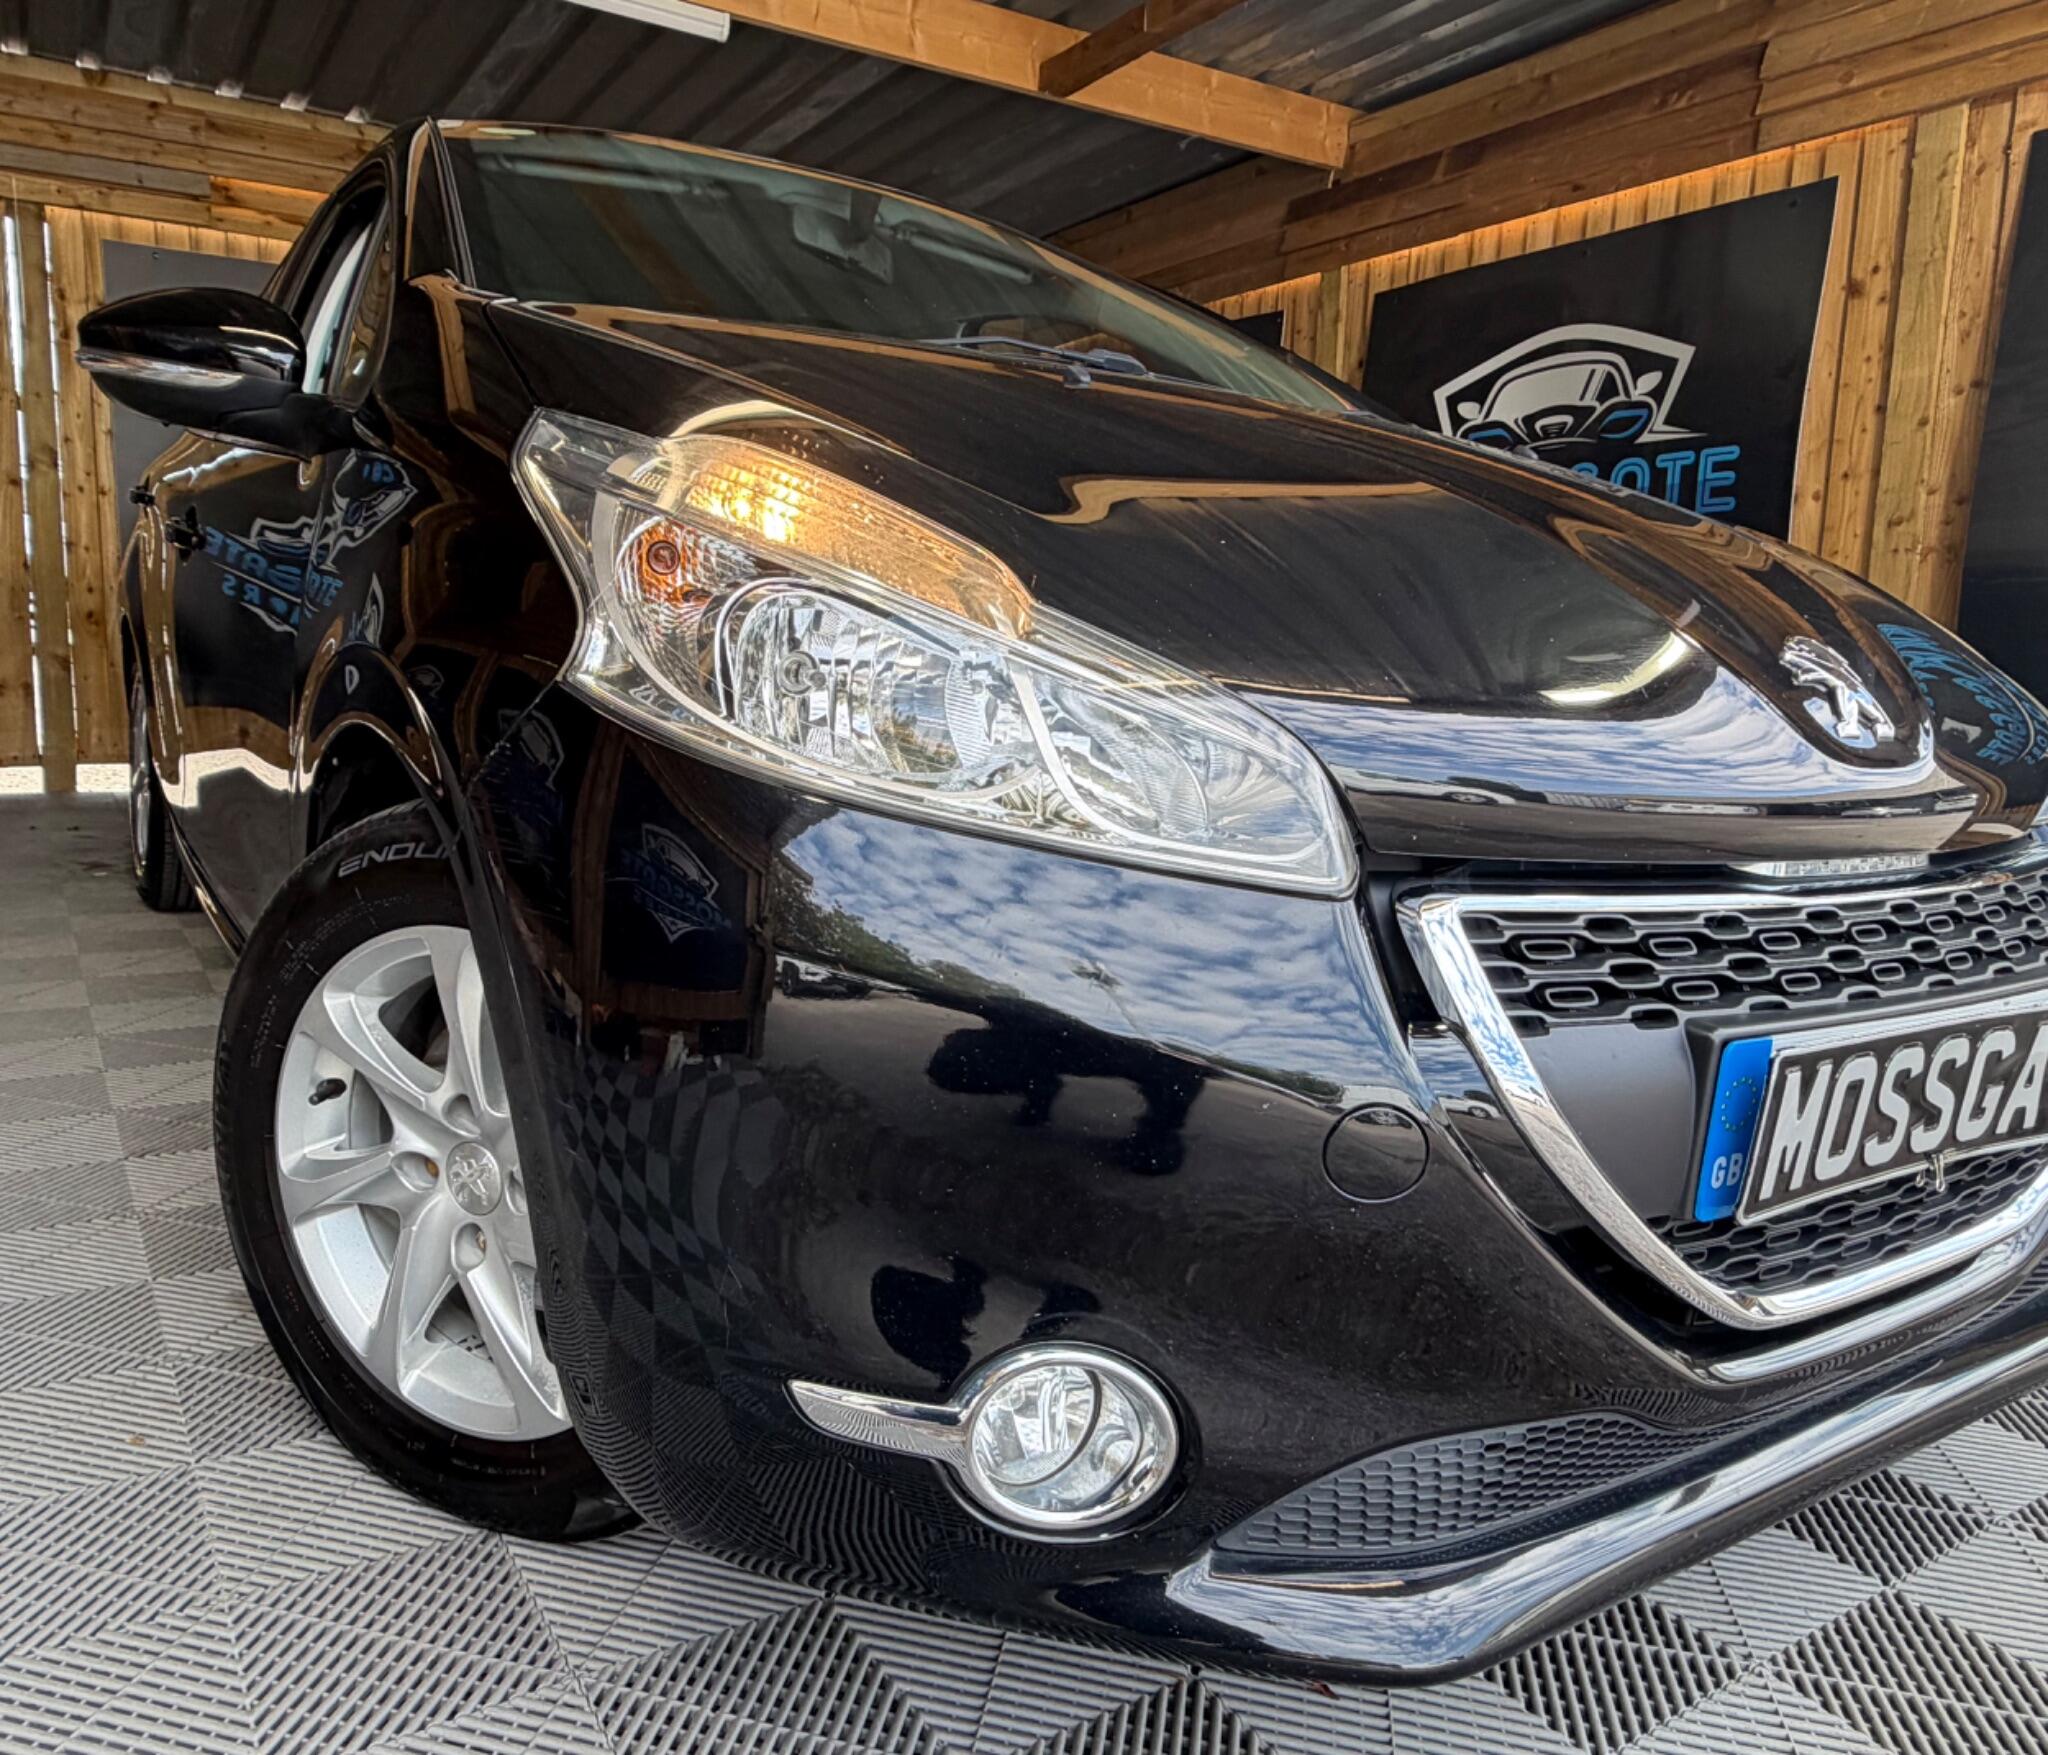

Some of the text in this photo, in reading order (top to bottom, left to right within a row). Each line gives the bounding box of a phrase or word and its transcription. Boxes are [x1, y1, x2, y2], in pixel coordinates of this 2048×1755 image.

[338, 842, 449, 878] ENDU
[1759, 1022, 2048, 1201] MOSSGA
[1711, 1152, 1744, 1190] GB
